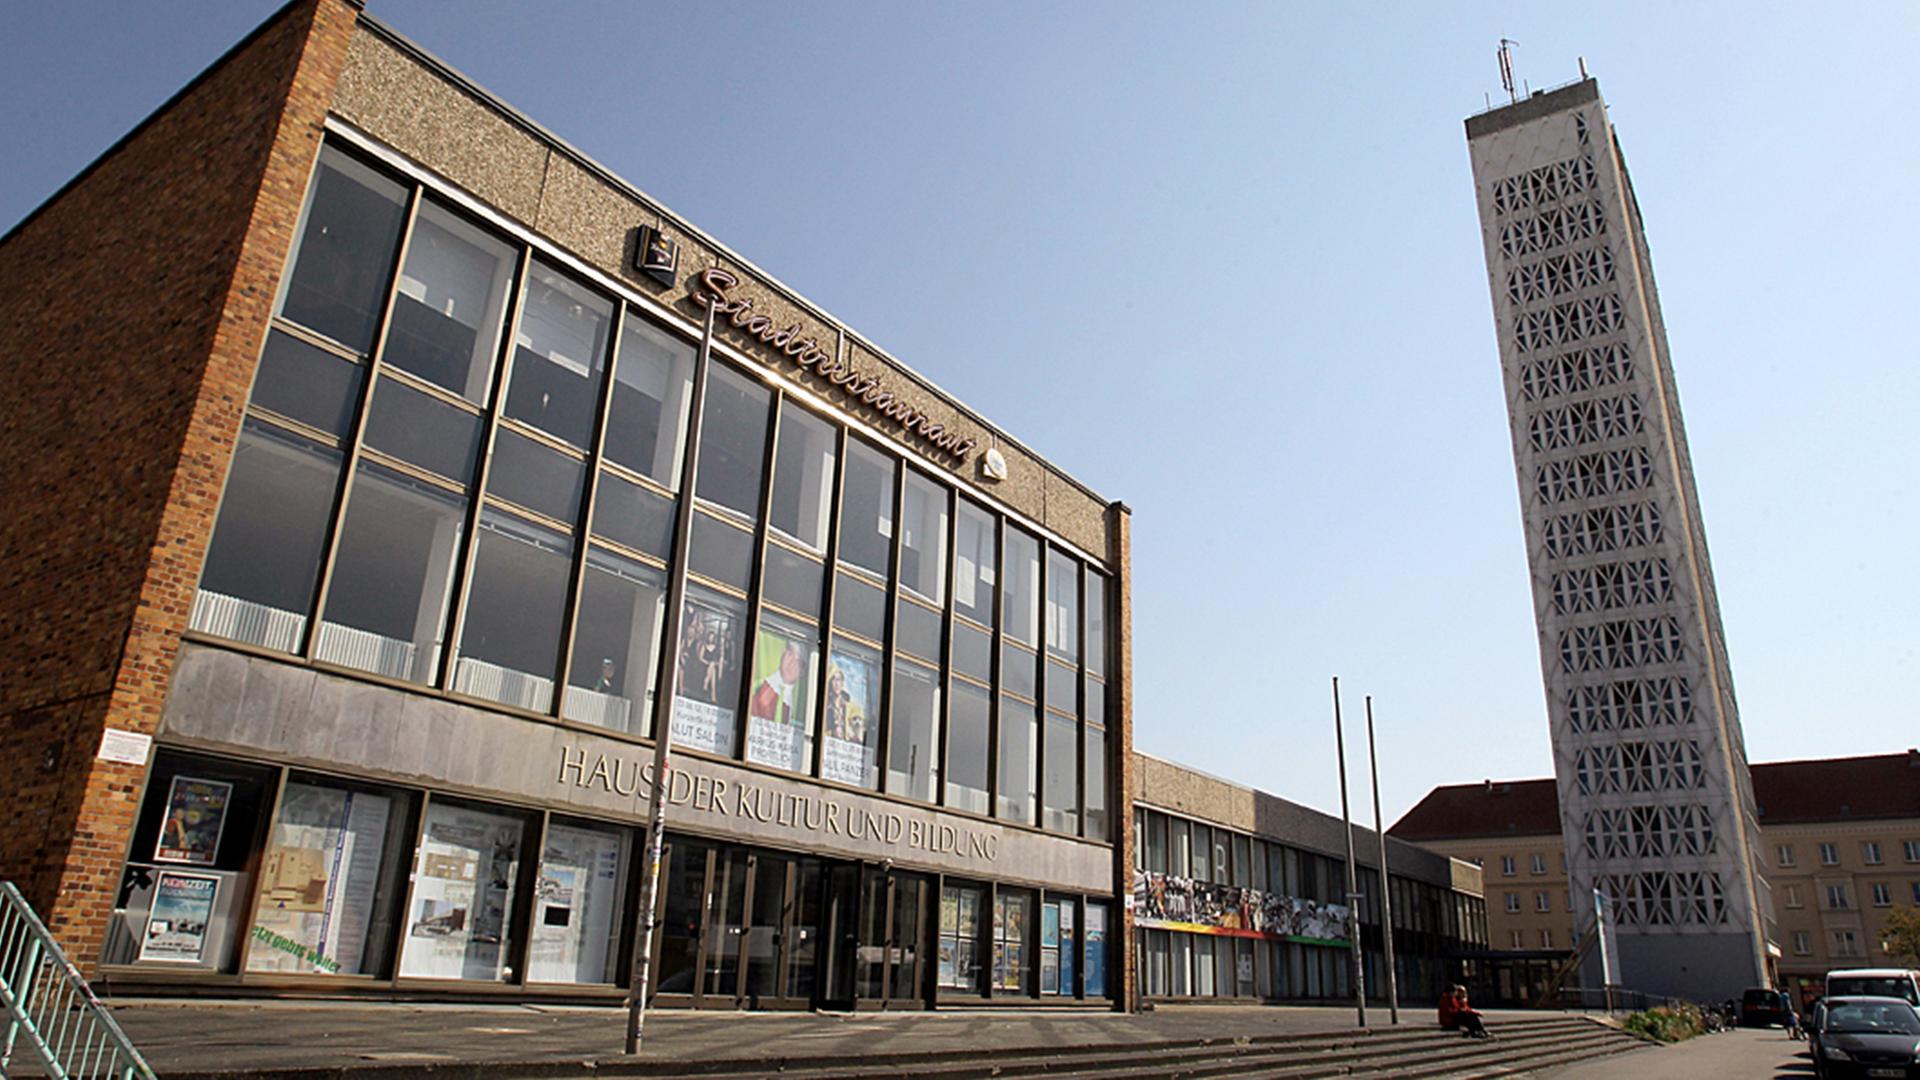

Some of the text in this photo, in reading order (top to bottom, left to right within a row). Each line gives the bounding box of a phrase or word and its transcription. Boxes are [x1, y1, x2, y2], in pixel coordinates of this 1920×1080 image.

[691, 267, 978, 464] Stadtrestaurant
[558, 746, 999, 862] HAUS DER KULTUR UND BILDUNG
